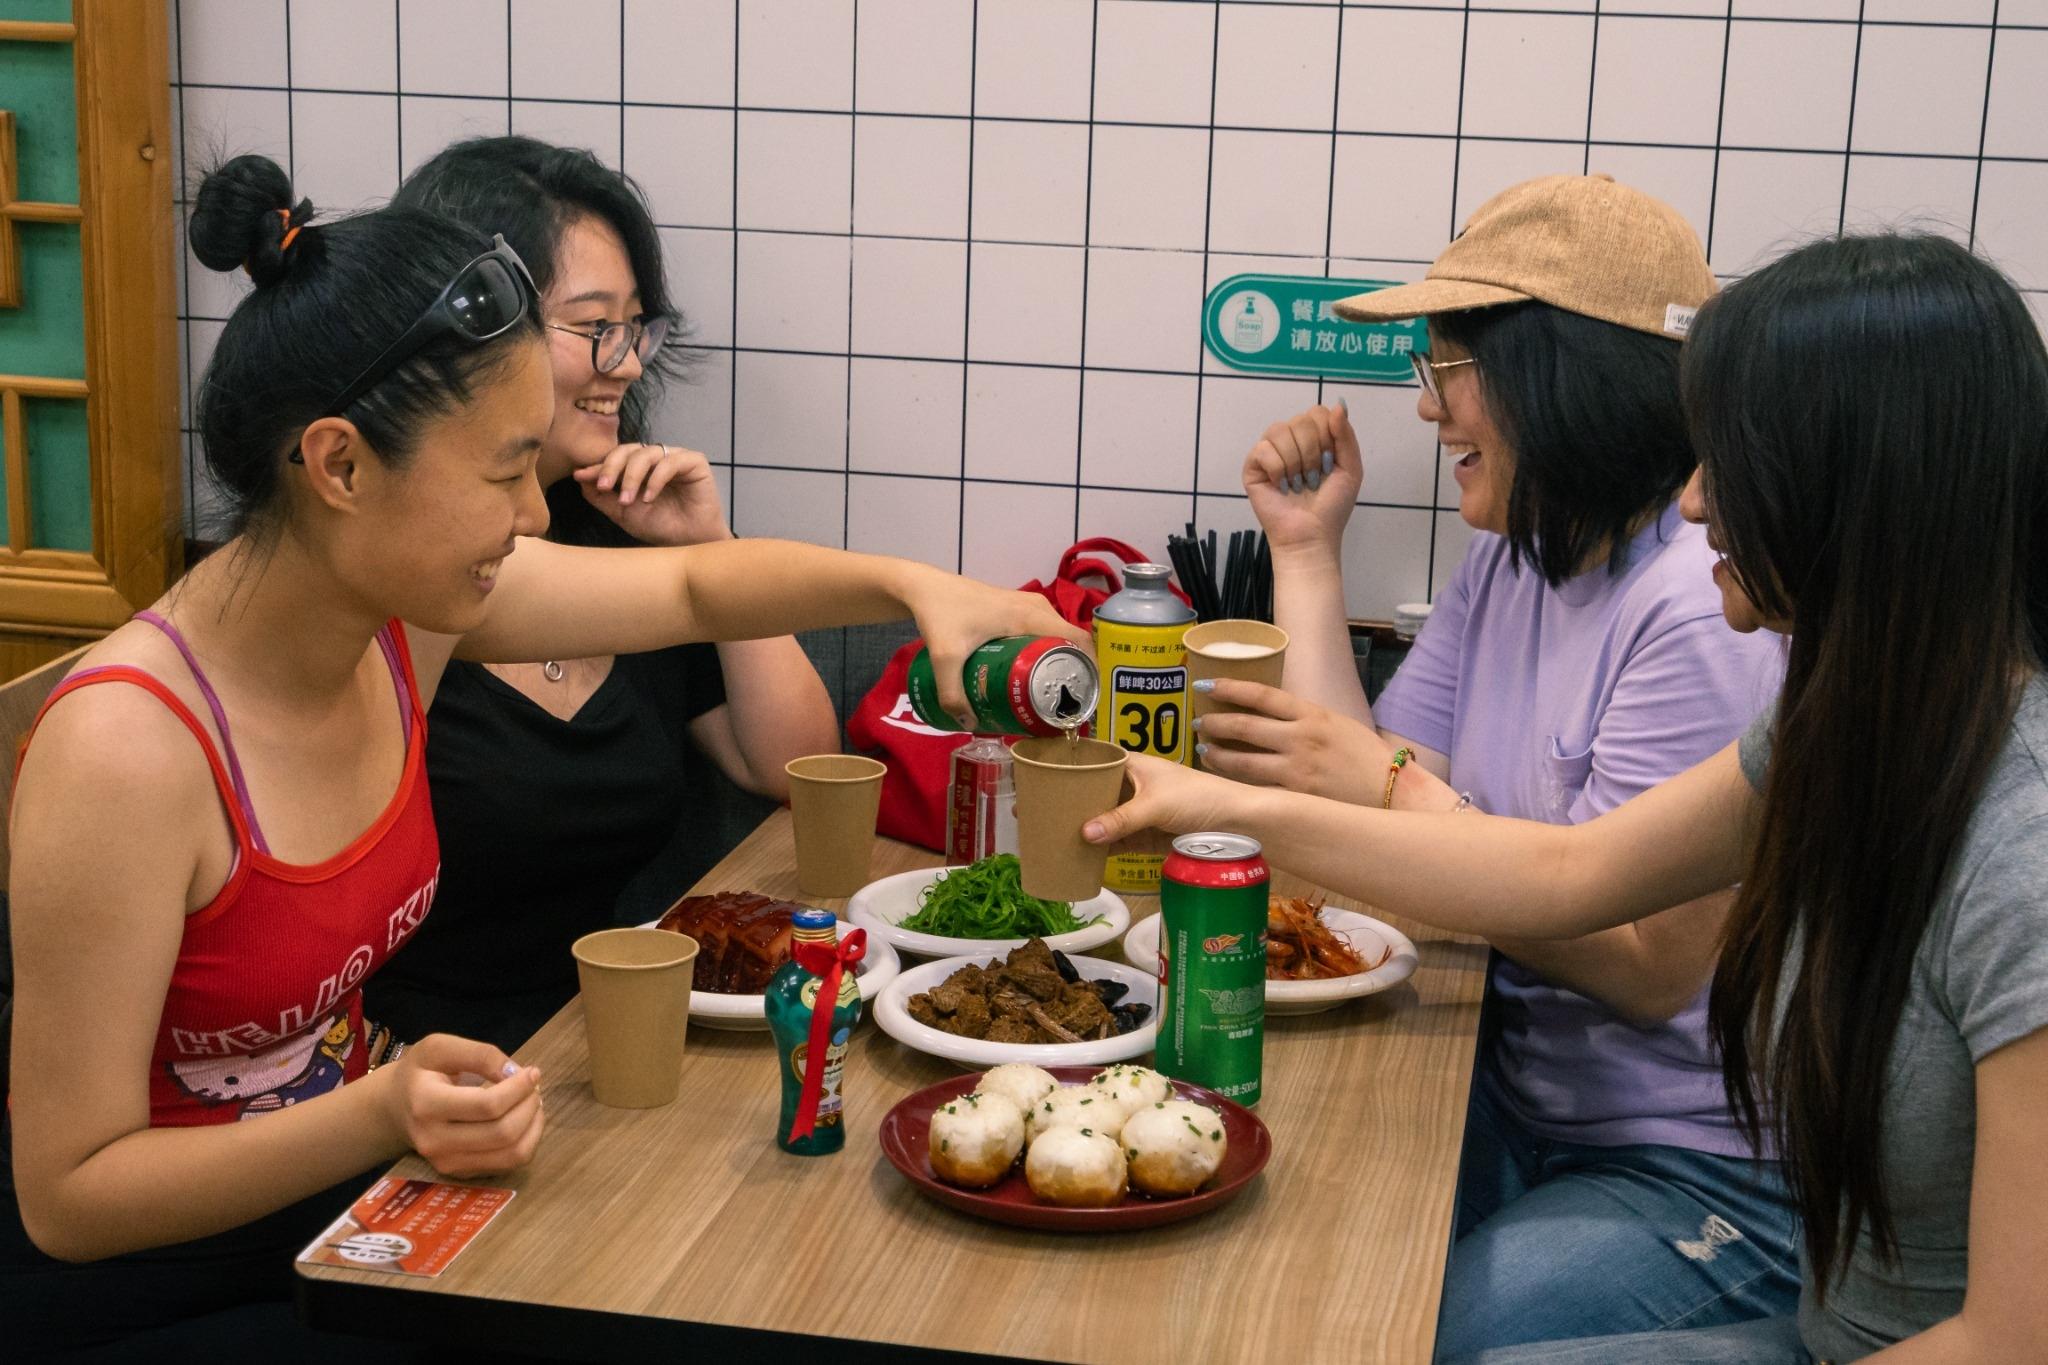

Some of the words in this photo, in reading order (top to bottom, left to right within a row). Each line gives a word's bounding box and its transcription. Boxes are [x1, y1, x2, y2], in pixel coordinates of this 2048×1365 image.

[1290, 327, 1414, 357] 请放心使用
[1119, 675, 1183, 690] 鲜啤30公里
[1119, 702, 1180, 754] 30
[1220, 872, 1246, 884] 中国的
